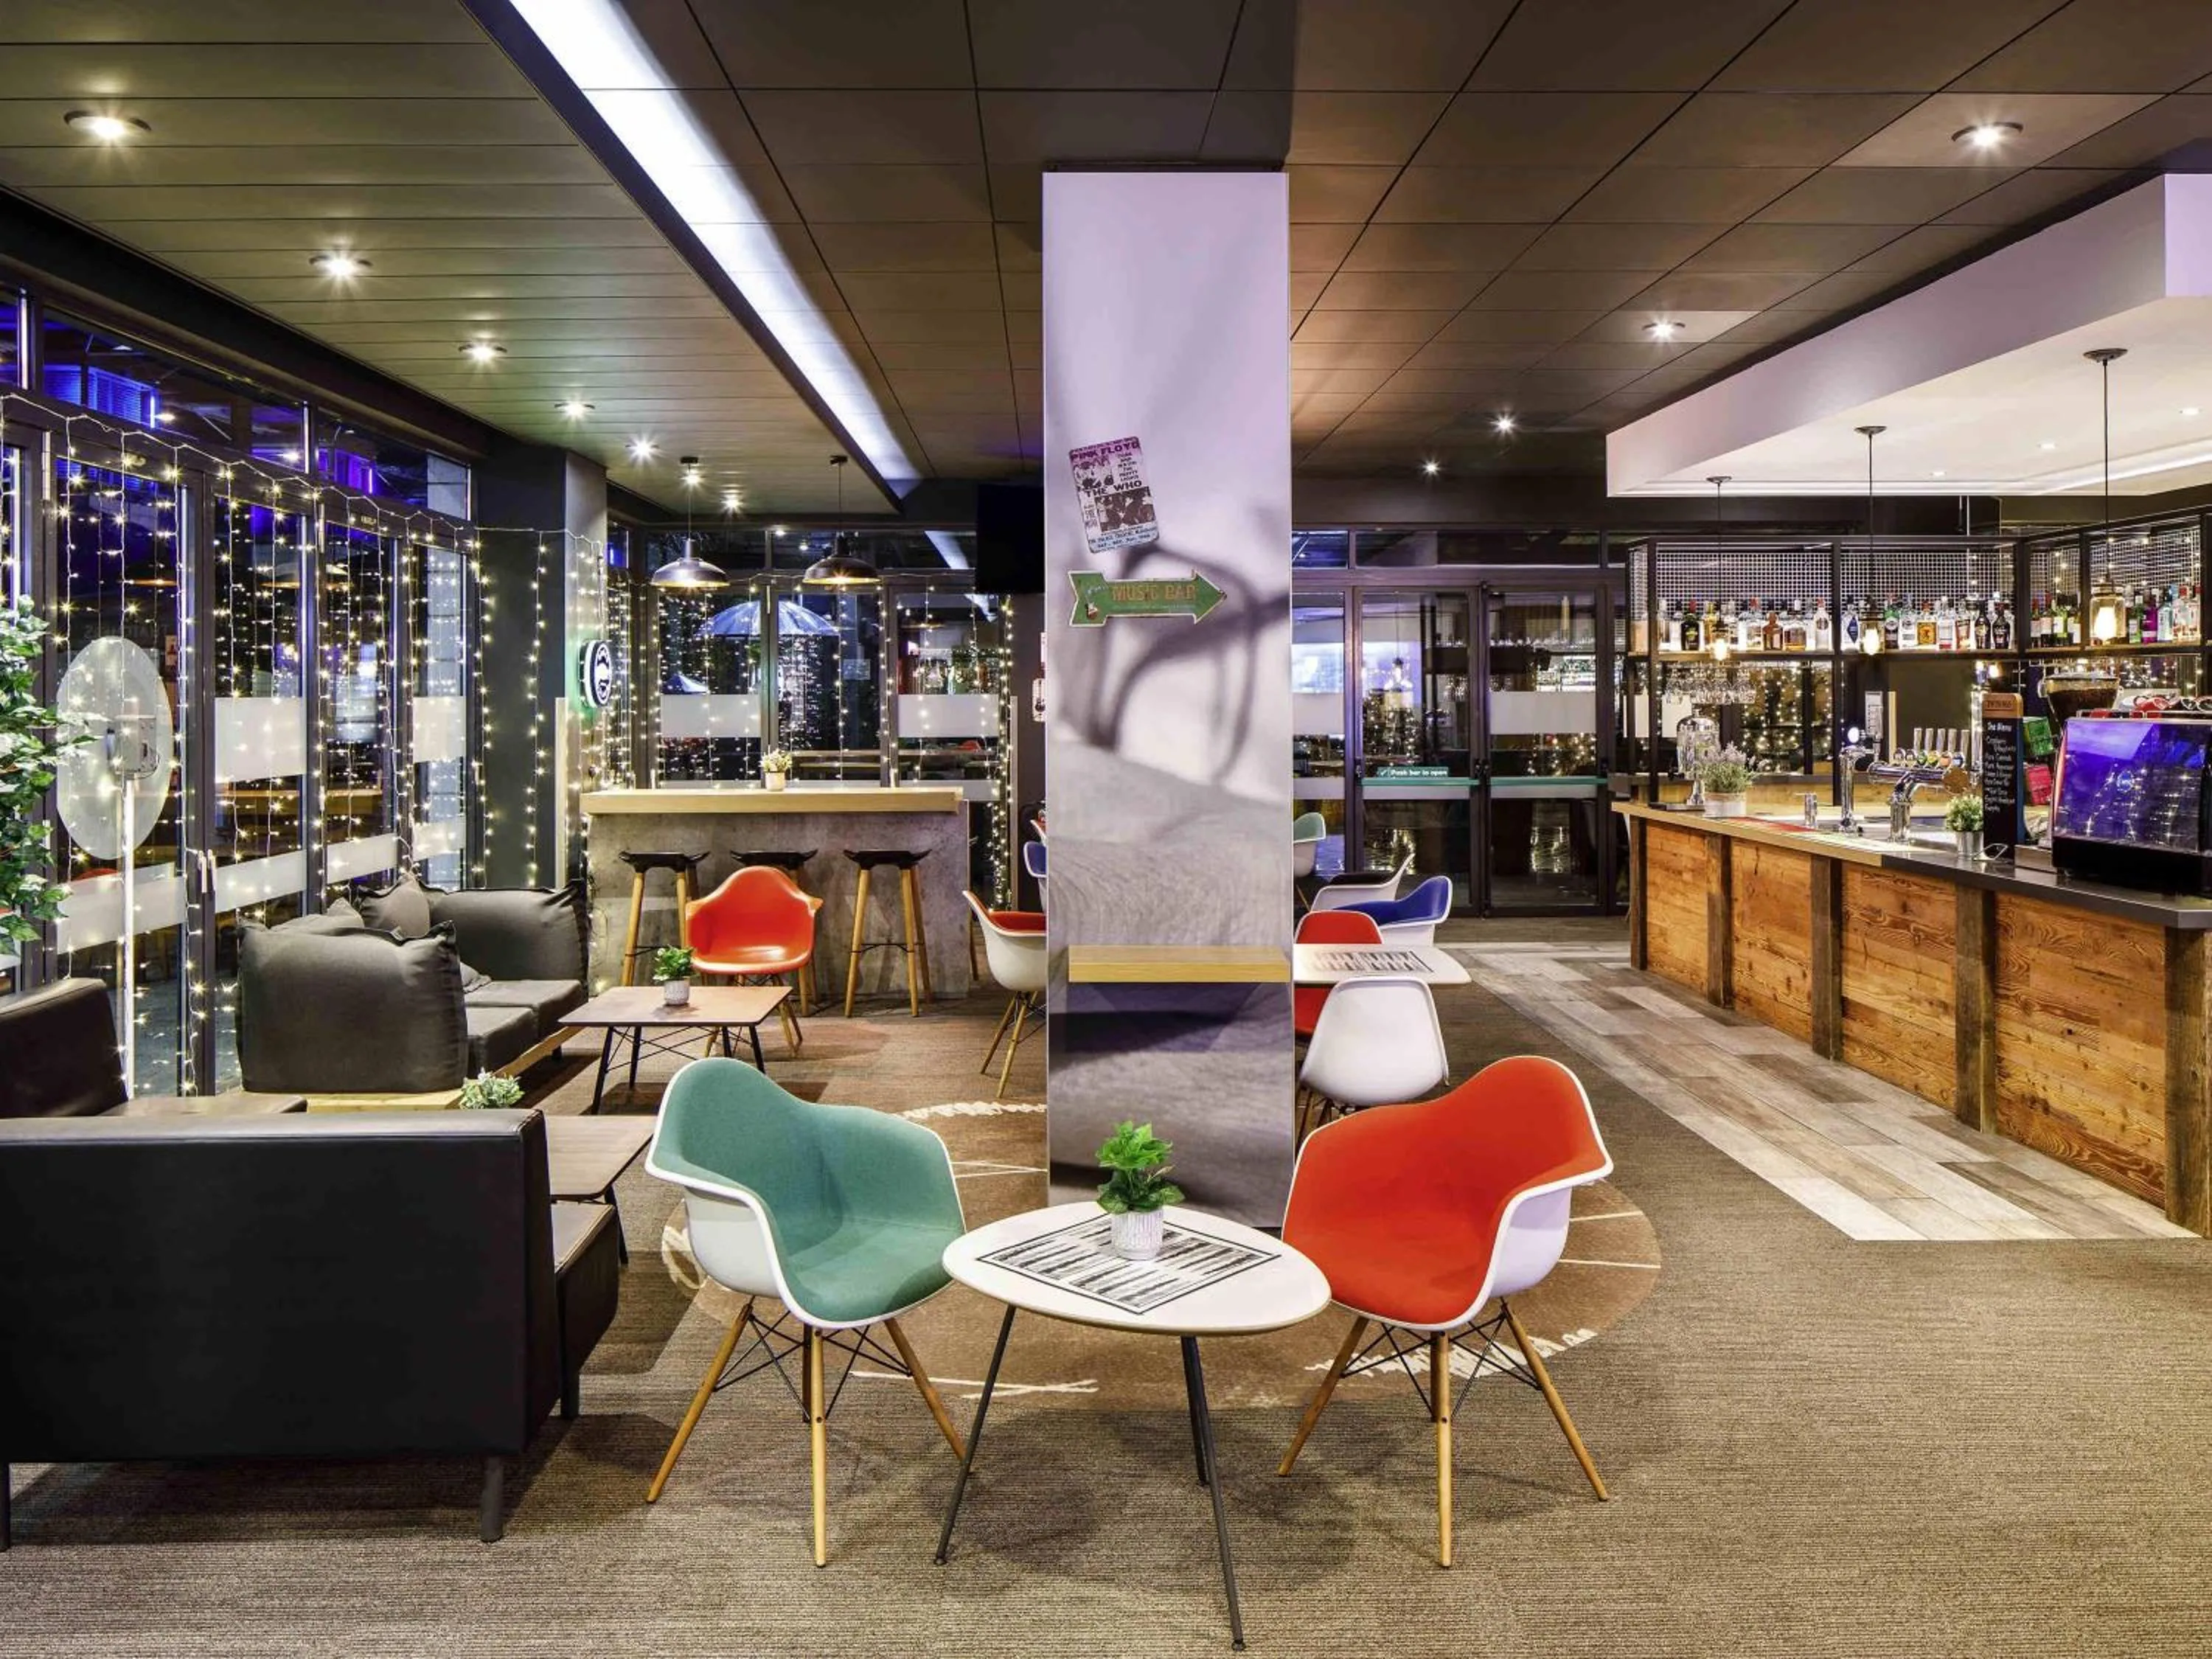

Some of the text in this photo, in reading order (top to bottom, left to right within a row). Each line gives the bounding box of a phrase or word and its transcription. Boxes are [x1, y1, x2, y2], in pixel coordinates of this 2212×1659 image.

[1070, 449, 1098, 461] PINK
[1099, 442, 1139, 454] FLOYD
[1085, 480, 1142, 498] THE WHO
[1112, 584, 1196, 601] MUSIC BAR
